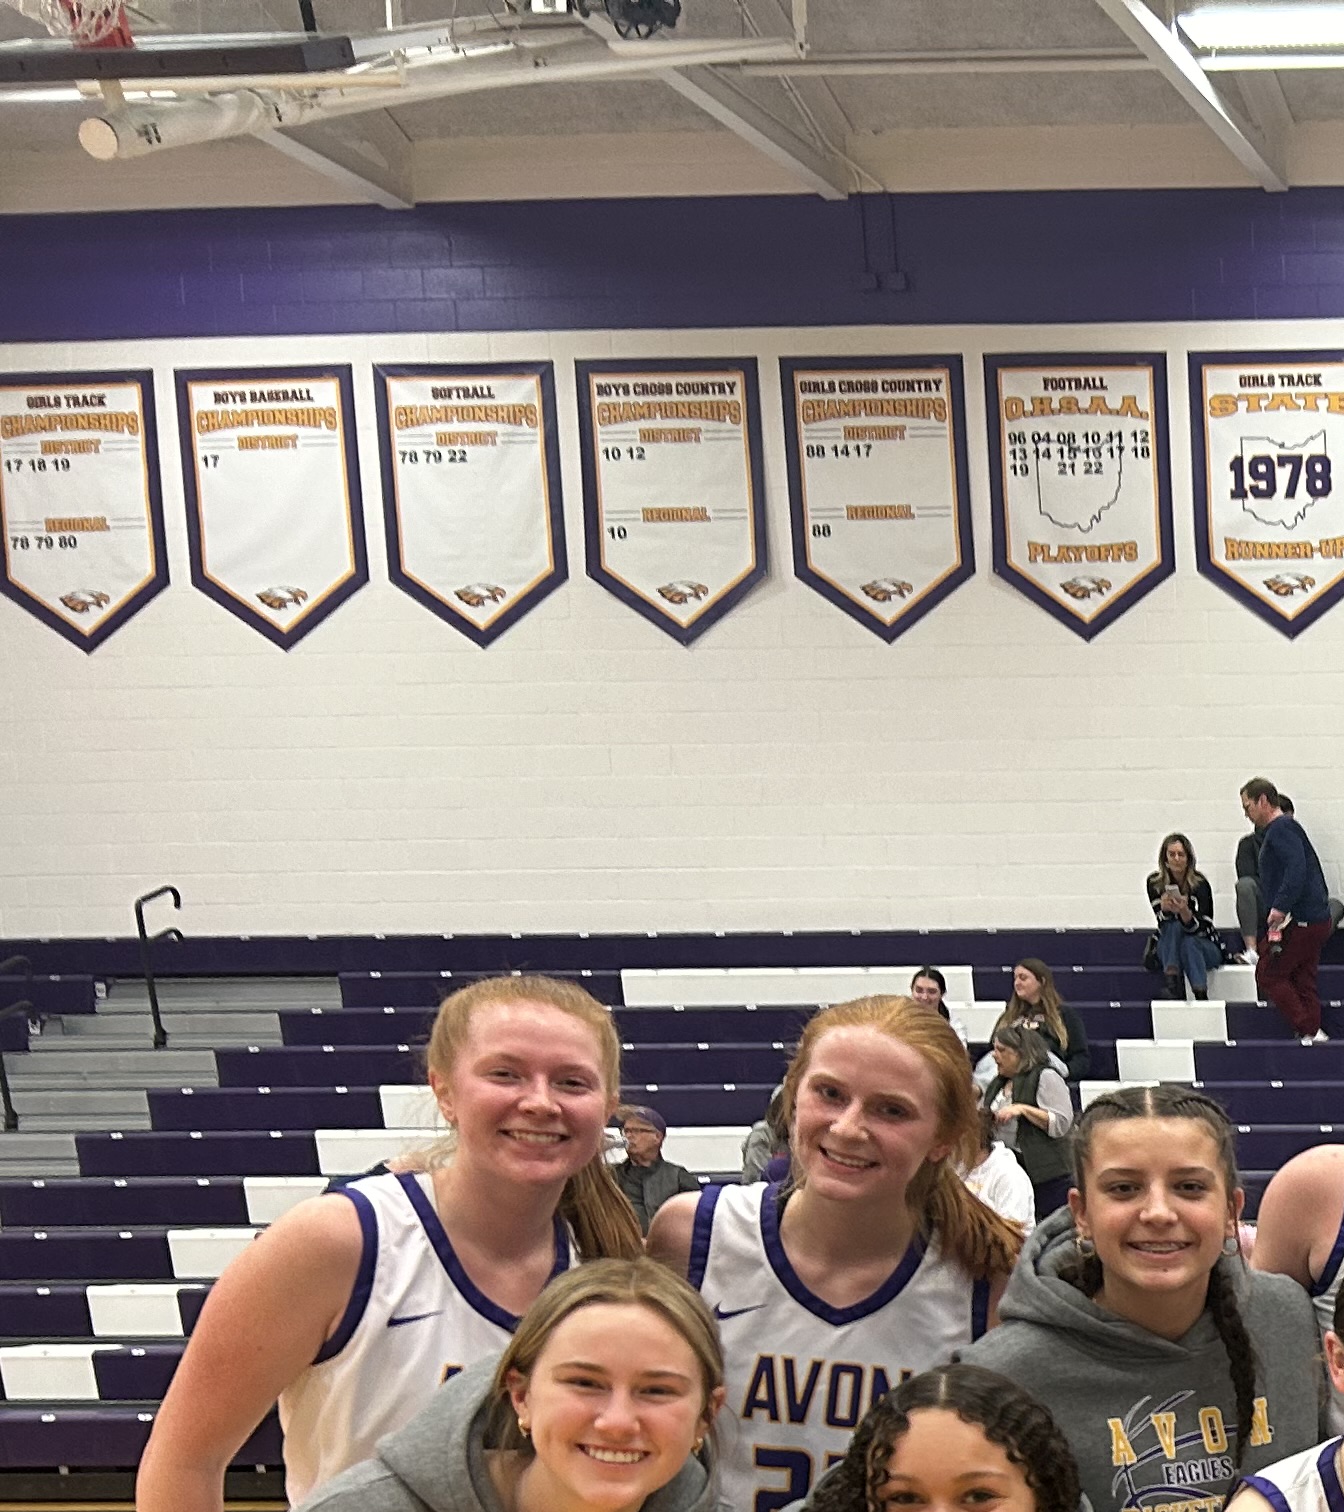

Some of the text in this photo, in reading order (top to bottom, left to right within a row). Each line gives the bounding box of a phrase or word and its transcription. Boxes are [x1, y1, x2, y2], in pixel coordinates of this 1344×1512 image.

[596, 381, 736, 396] BOYS CROSS COUNTRY
[800, 378, 942, 394] GIRLS CROSS COUNTRY
[1043, 377, 1108, 391] FOOTBALL
[1239, 373, 1322, 388] GIRLS TRACK
[64, 393, 106, 408] TRACK
[213, 391, 246, 405] BOYS
[431, 386, 495, 400] SOFTBALL
[395, 403, 538, 430] CHAMPIONSHIPS
[597, 400, 741, 427] CHAMPIONSHIPS
[801, 397, 947, 425] CHAMPIONSHIPS
[1005, 395, 1149, 422] O.H.S.A.A.
[0, 411, 139, 440] CHAMPIONSHIPS
[197, 407, 337, 435] CHAMPIONSHIPS
[435, 431, 498, 446] DISTRICT
[639, 427, 702, 443] DISTRICT
[843, 424, 906, 441] DISTRICT
[1082, 431, 1101, 444] 10
[1131, 429, 1149, 444] 12
[603, 446, 646, 461] 10 12
[831, 444, 850, 459] 14
[853, 443, 872, 458] 17
[5, 459, 22, 473] 17
[202, 454, 219, 469] 17
[1230, 454, 1333, 500] 1978
[642, 507, 711, 523] REGIONAL
[846, 505, 915, 521] REGIONAL
[608, 526, 627, 540] 10
[1028, 541, 1138, 562] PLAYOFFS
[1107, 1397, 1272, 1466] AVON
[1162, 1456, 1235, 1485] EAGLES
